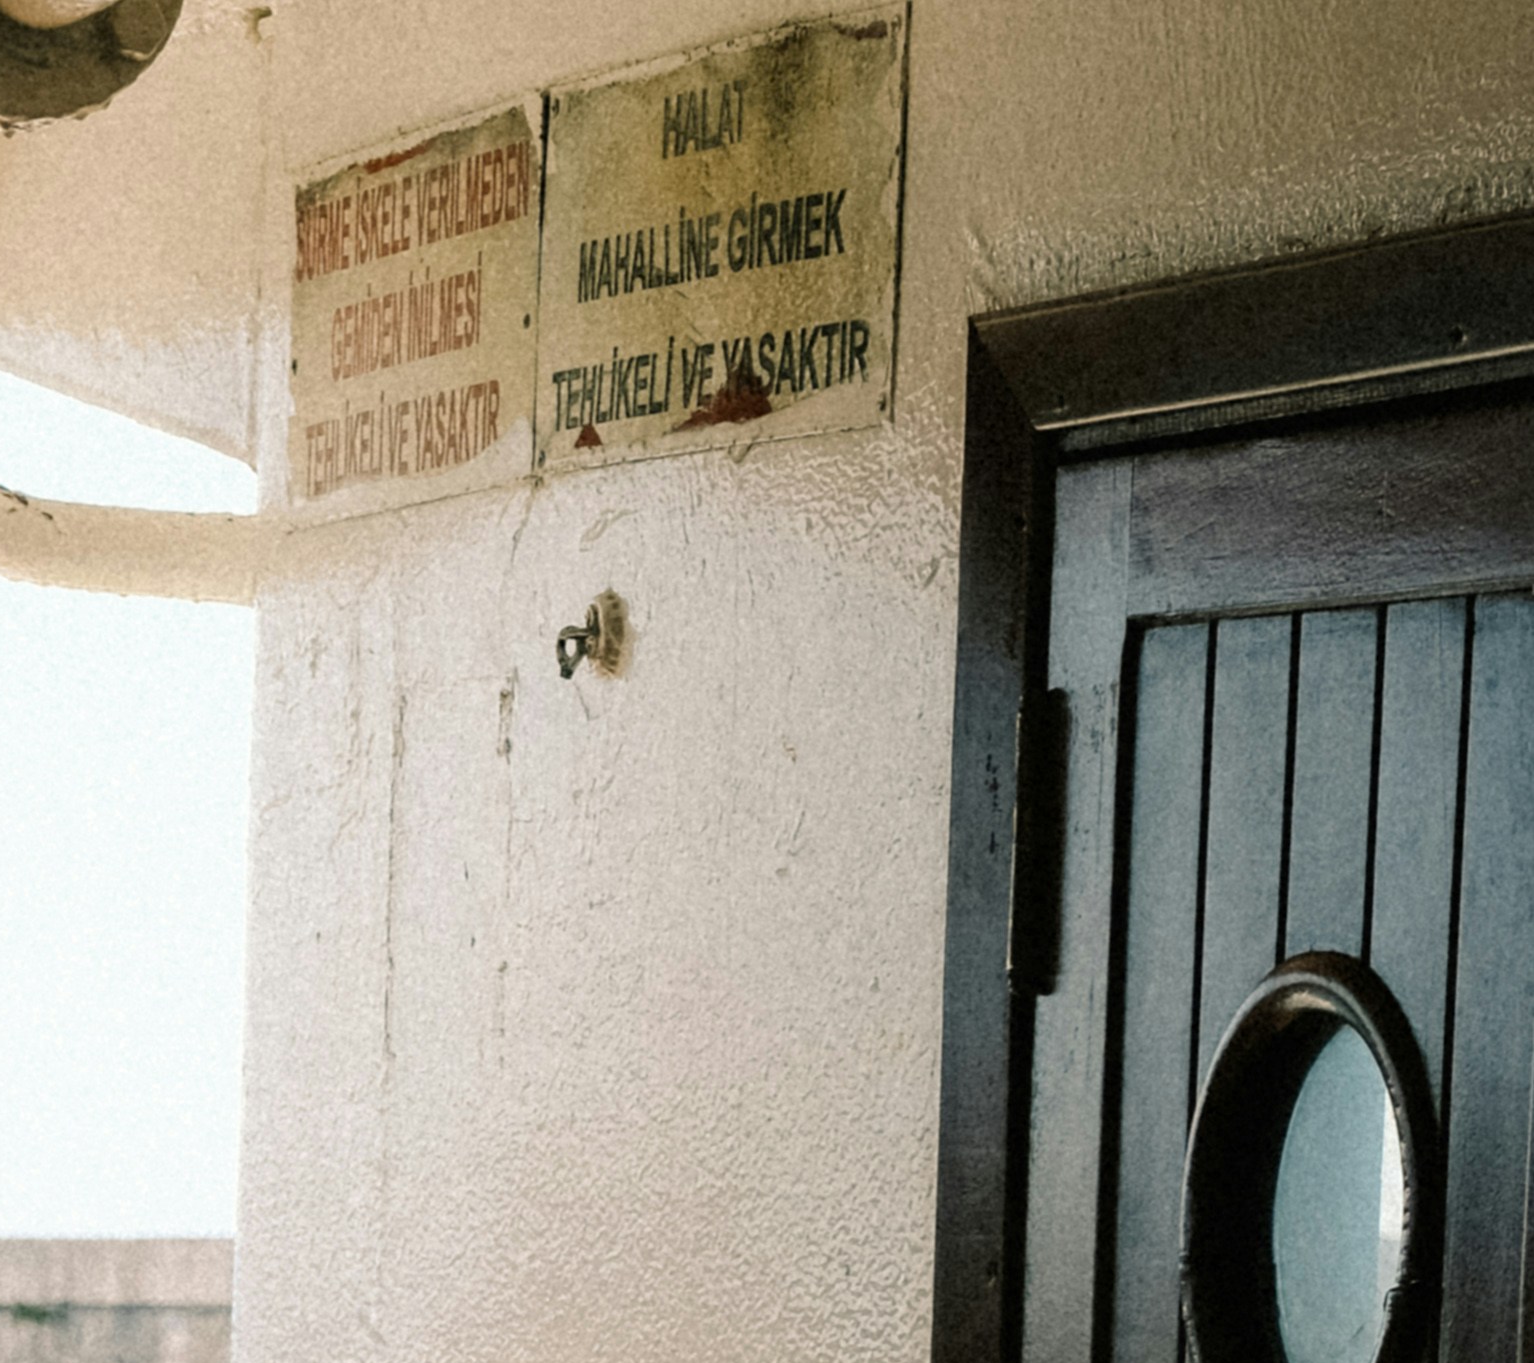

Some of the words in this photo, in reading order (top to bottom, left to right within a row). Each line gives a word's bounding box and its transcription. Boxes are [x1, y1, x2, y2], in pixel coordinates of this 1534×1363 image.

[662, 80, 748, 160] HALAT
[578, 206, 721, 304] MAHALLİNE
[726, 188, 848, 273] GİRMEK
[388, 401, 410, 477] VE
[414, 379, 500, 474] YASAKTIR
[552, 336, 675, 432] TEHLİKELİ
[681, 344, 716, 410] VE
[720, 319, 871, 397] YASAKTIR
